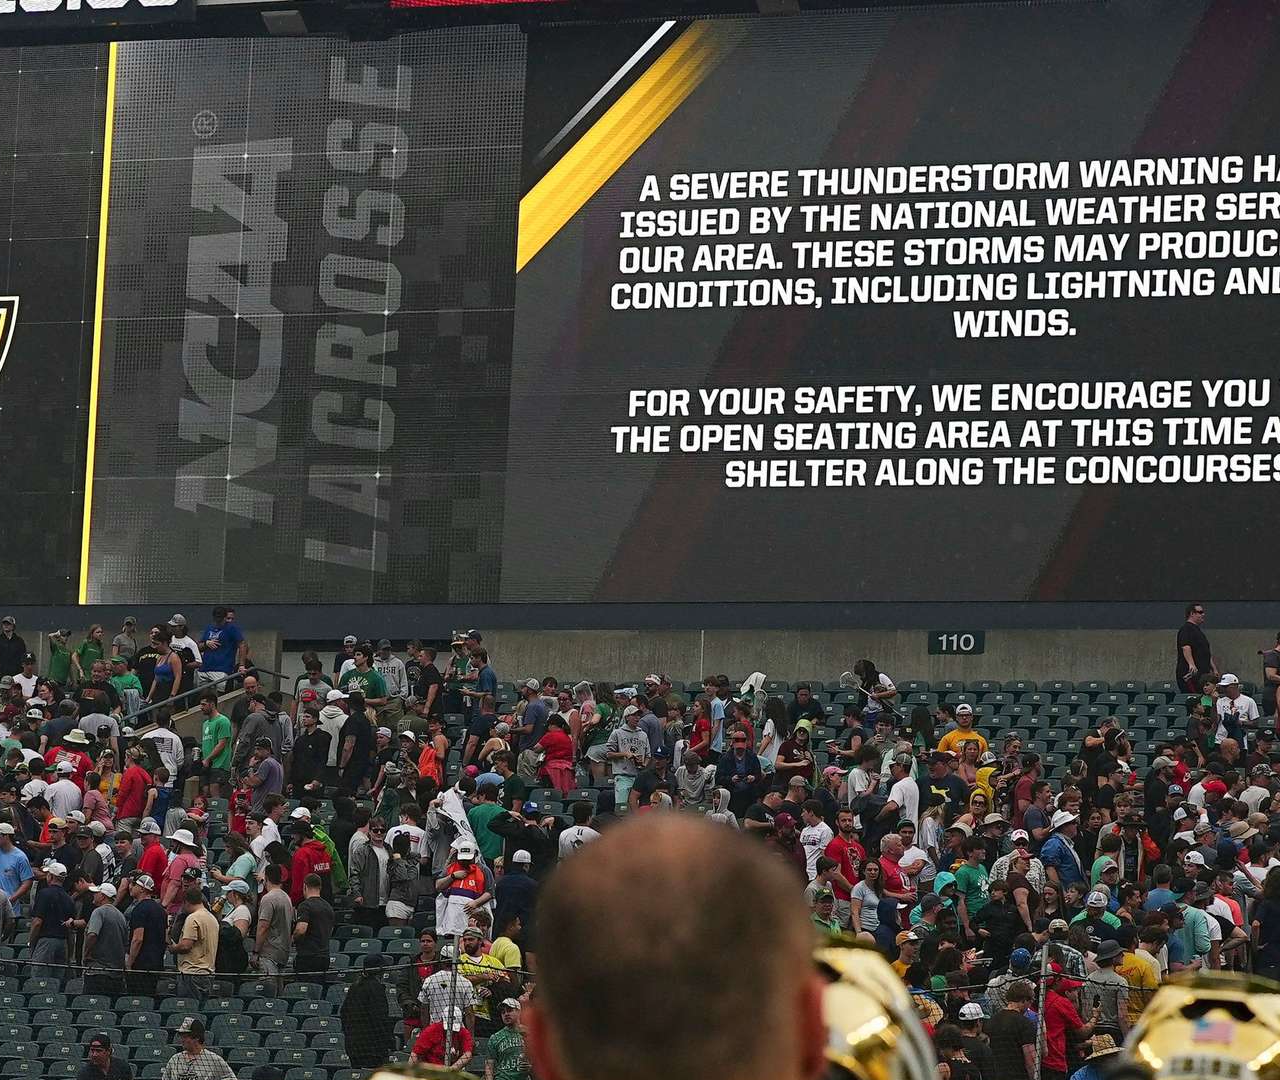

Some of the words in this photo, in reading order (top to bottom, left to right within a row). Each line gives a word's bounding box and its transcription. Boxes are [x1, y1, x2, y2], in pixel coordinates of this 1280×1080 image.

[639, 174, 661, 202] A
[669, 170, 790, 201] SEVERE
[797, 161, 1070, 197] THUNDERSTORM
[1079, 155, 1244, 188] WARNING
[619, 207, 740, 238] ISSUED
[749, 206, 793, 234] BY
[799, 204, 862, 233] THE
[870, 199, 1036, 231] NATIONAL
[1045, 194, 1206, 226] WEATHER
[619, 245, 685, 274] OUR
[691, 242, 783, 272] AREA.
[791, 239, 895, 269] THESE
[903, 235, 1045, 266] STORMS
[1054, 233, 1130, 263] MAY
[610, 278, 823, 310] CONDITIONS,
[830, 273, 1018, 305] INCLUDING
[1027, 268, 1215, 300] LIGHTNING
[175, 137, 293, 526] NCAA
[304, 55, 414, 574] LACROSSE
[953, 308, 1077, 338] WINDS.
[628, 389, 690, 418] FOR
[698, 387, 786, 416] YOUR
[794, 385, 923, 417] SAFETY,
[931, 383, 982, 412] WE
[991, 380, 1193, 411] ENCOURAGE
[1201, 378, 1271, 408] YOU
[610, 425, 671, 454] THE
[679, 423, 764, 453] OPEN
[773, 421, 917, 451] SEATING
[924, 420, 1012, 449] AREA
[1019, 419, 1063, 448] AT
[1070, 418, 1154, 447] THIS
[1162, 416, 1253, 446] TIME
[725, 458, 867, 488] SHELTER
[874, 457, 984, 486] ALONG
[992, 456, 1056, 485] THE
[938, 633, 975, 651] 110
